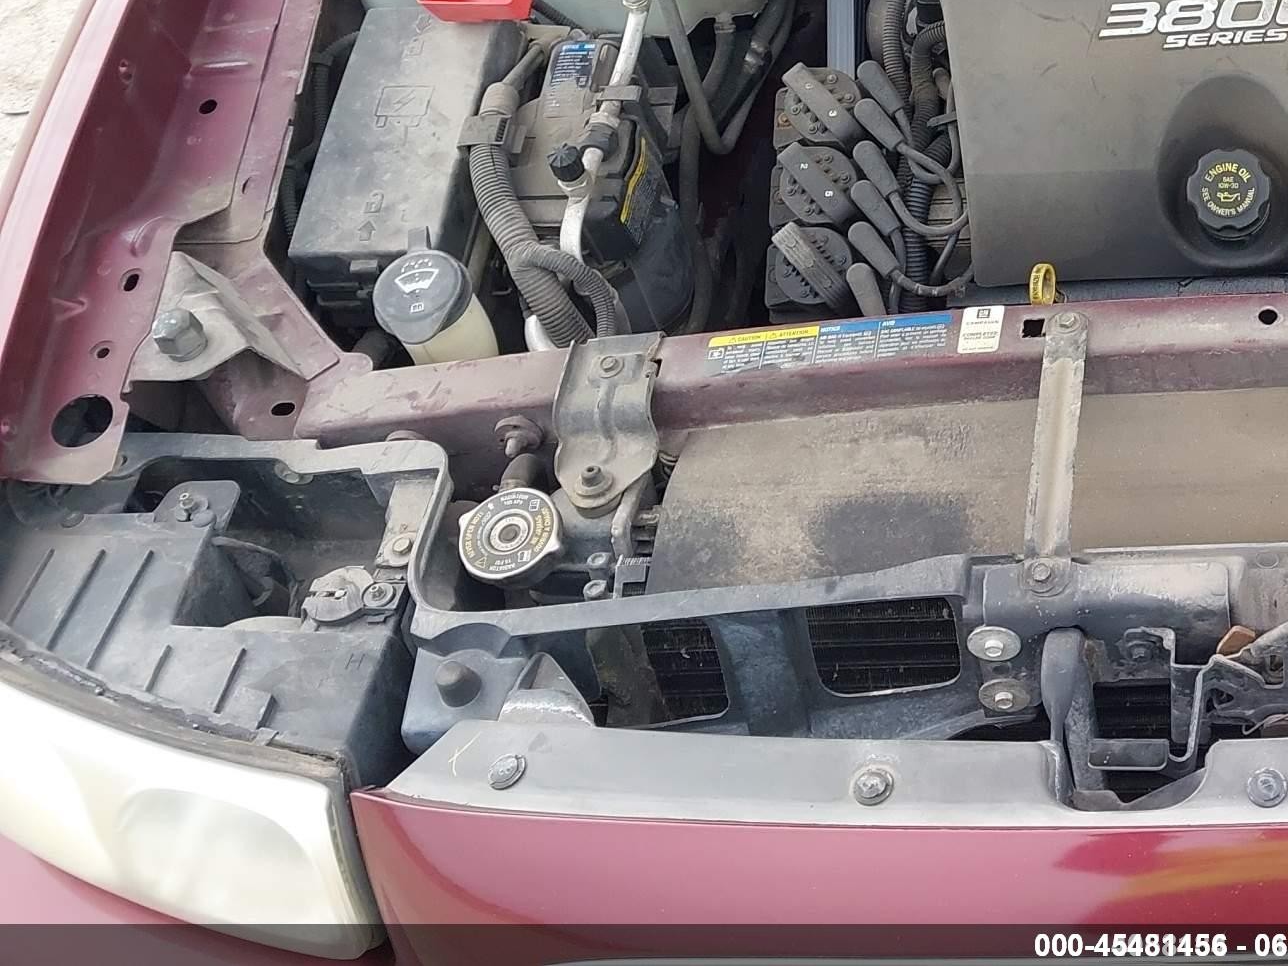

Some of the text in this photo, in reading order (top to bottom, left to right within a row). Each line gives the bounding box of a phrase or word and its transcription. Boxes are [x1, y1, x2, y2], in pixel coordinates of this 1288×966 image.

[1161, 26, 1288, 50] SERIES
[1204, 162, 1252, 183] ENGINE OIL
[1201, 187, 1255, 217] SEE OWNER'S MANUAL
[779, 329, 809, 337] ATTENTION
